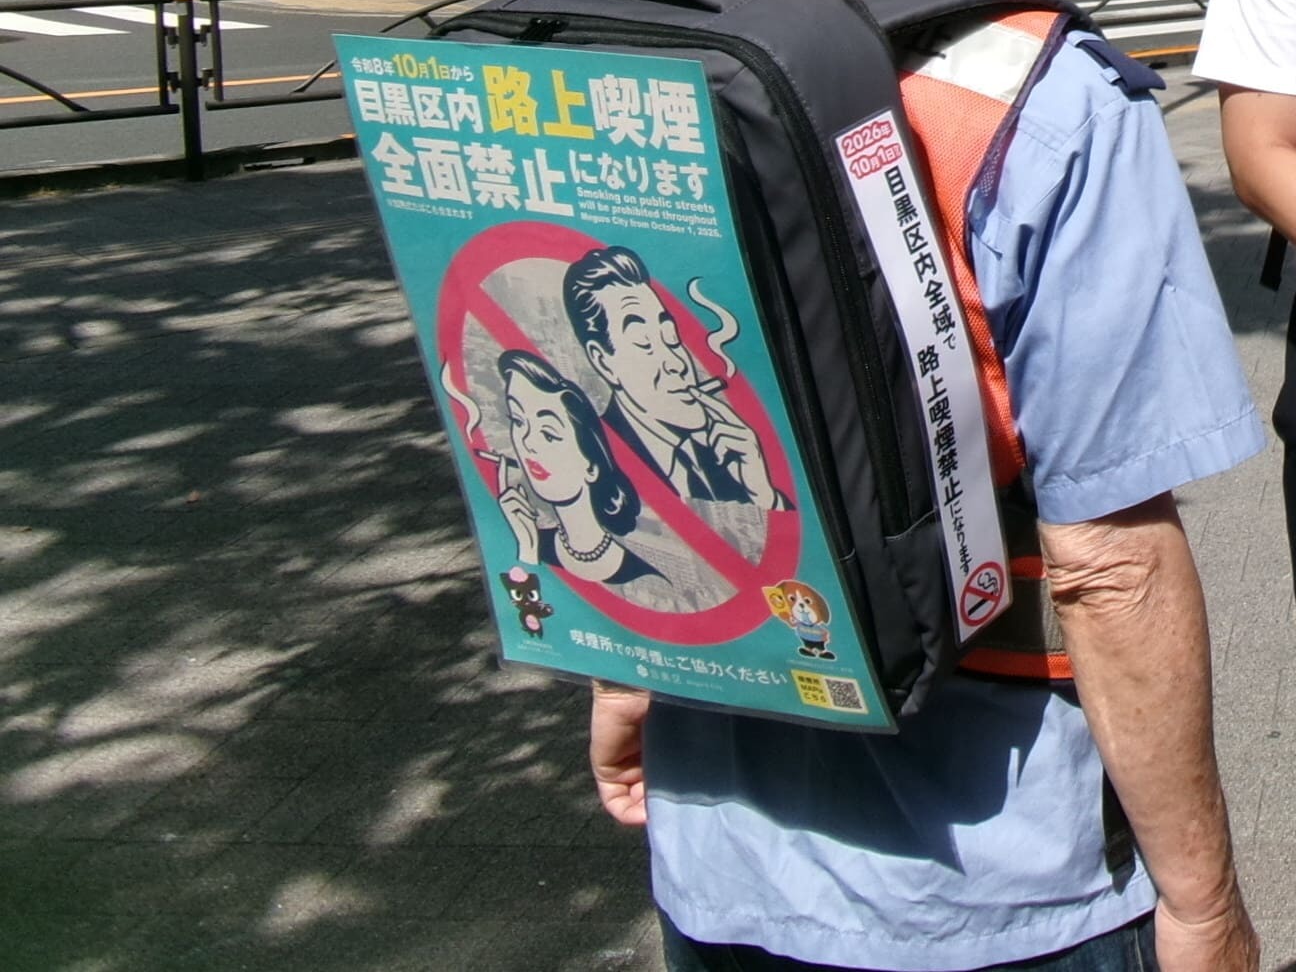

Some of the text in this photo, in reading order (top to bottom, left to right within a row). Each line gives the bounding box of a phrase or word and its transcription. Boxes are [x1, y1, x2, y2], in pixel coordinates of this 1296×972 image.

[350, 54, 474, 82] 令和8年10月1日から
[371, 131, 708, 217] 全面禁止になります
[576, 186, 715, 214] Smoking on public streets
[579, 200, 718, 226] will be prohibited throughout
[651, 221, 685, 234] October
[884, 165, 956, 350] 目黒区内全域で
[916, 344, 973, 577] 路上喫煙禁止になります
[569, 629, 788, 685] 喫煙所での喫煙にご協力ください
